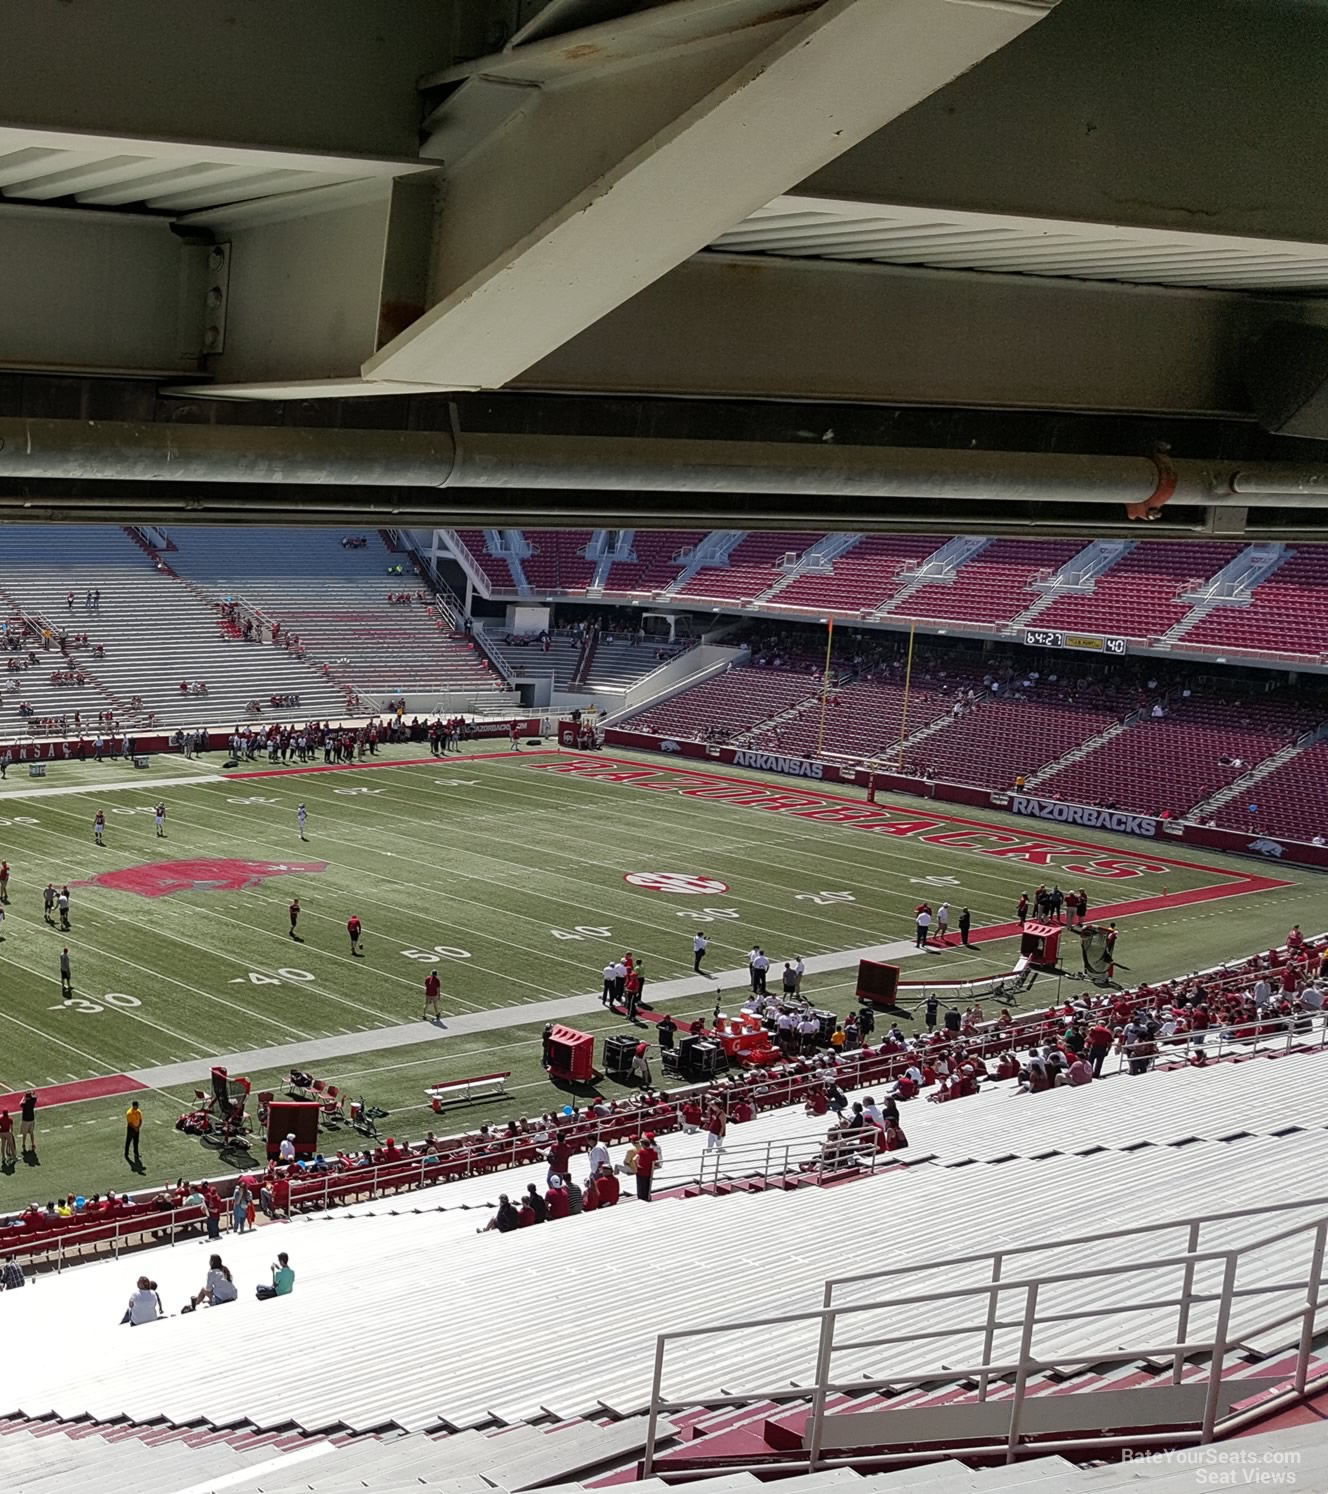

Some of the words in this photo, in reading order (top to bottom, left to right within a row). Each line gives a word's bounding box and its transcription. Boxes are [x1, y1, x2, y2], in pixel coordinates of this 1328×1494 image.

[1107, 639, 1123, 652] 40
[733, 751, 822, 779] ARKANSAS
[521, 758, 1170, 880] RAZORBACKS
[1012, 797, 1156, 837] RAZORBACKS
[625, 872, 729, 895] SEC
[795, 891, 851, 904] 20
[676, 908, 735, 922] 30
[549, 925, 605, 942] 40
[399, 945, 472, 963] 50
[246, 967, 315, 986] 40
[63, 992, 142, 1014] 30
